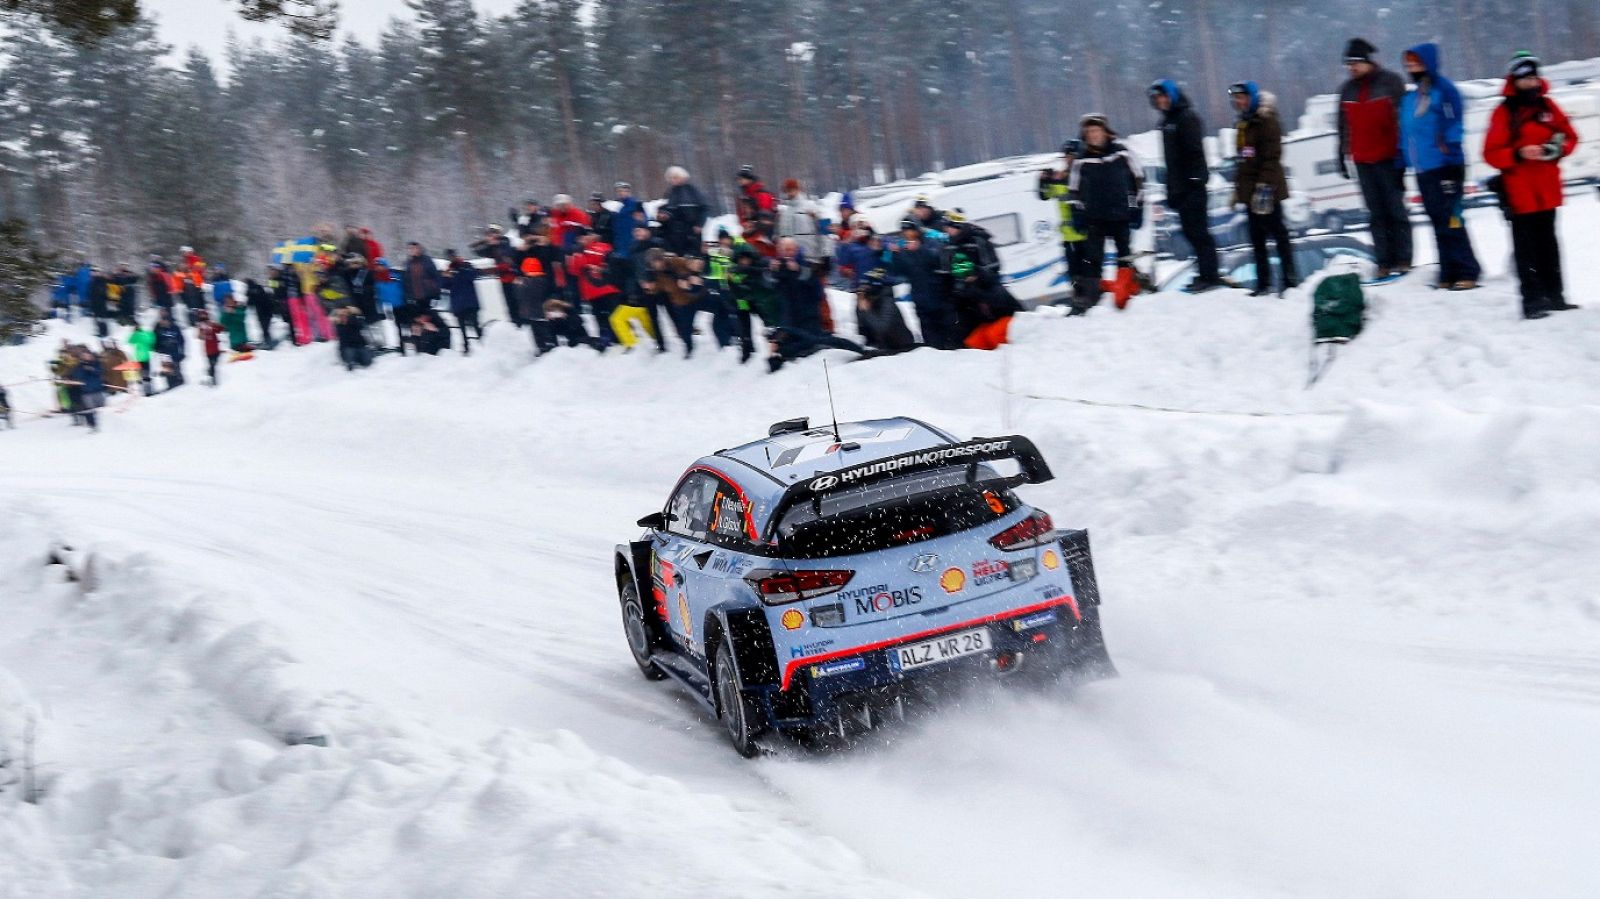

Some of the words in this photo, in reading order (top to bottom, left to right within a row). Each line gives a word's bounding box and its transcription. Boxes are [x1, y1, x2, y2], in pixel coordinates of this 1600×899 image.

[841, 456, 915, 483] HYUNDAI
[914, 440, 1010, 465] MOTORSPORT
[711, 491, 724, 532] 5
[837, 584, 889, 600] HYUNDAI
[973, 570, 1010, 586] ULTRA
[855, 586, 922, 616] MOBIS
[901, 644, 934, 668] ALZ
[937, 638, 961, 658] WR
[962, 632, 984, 652] 28
